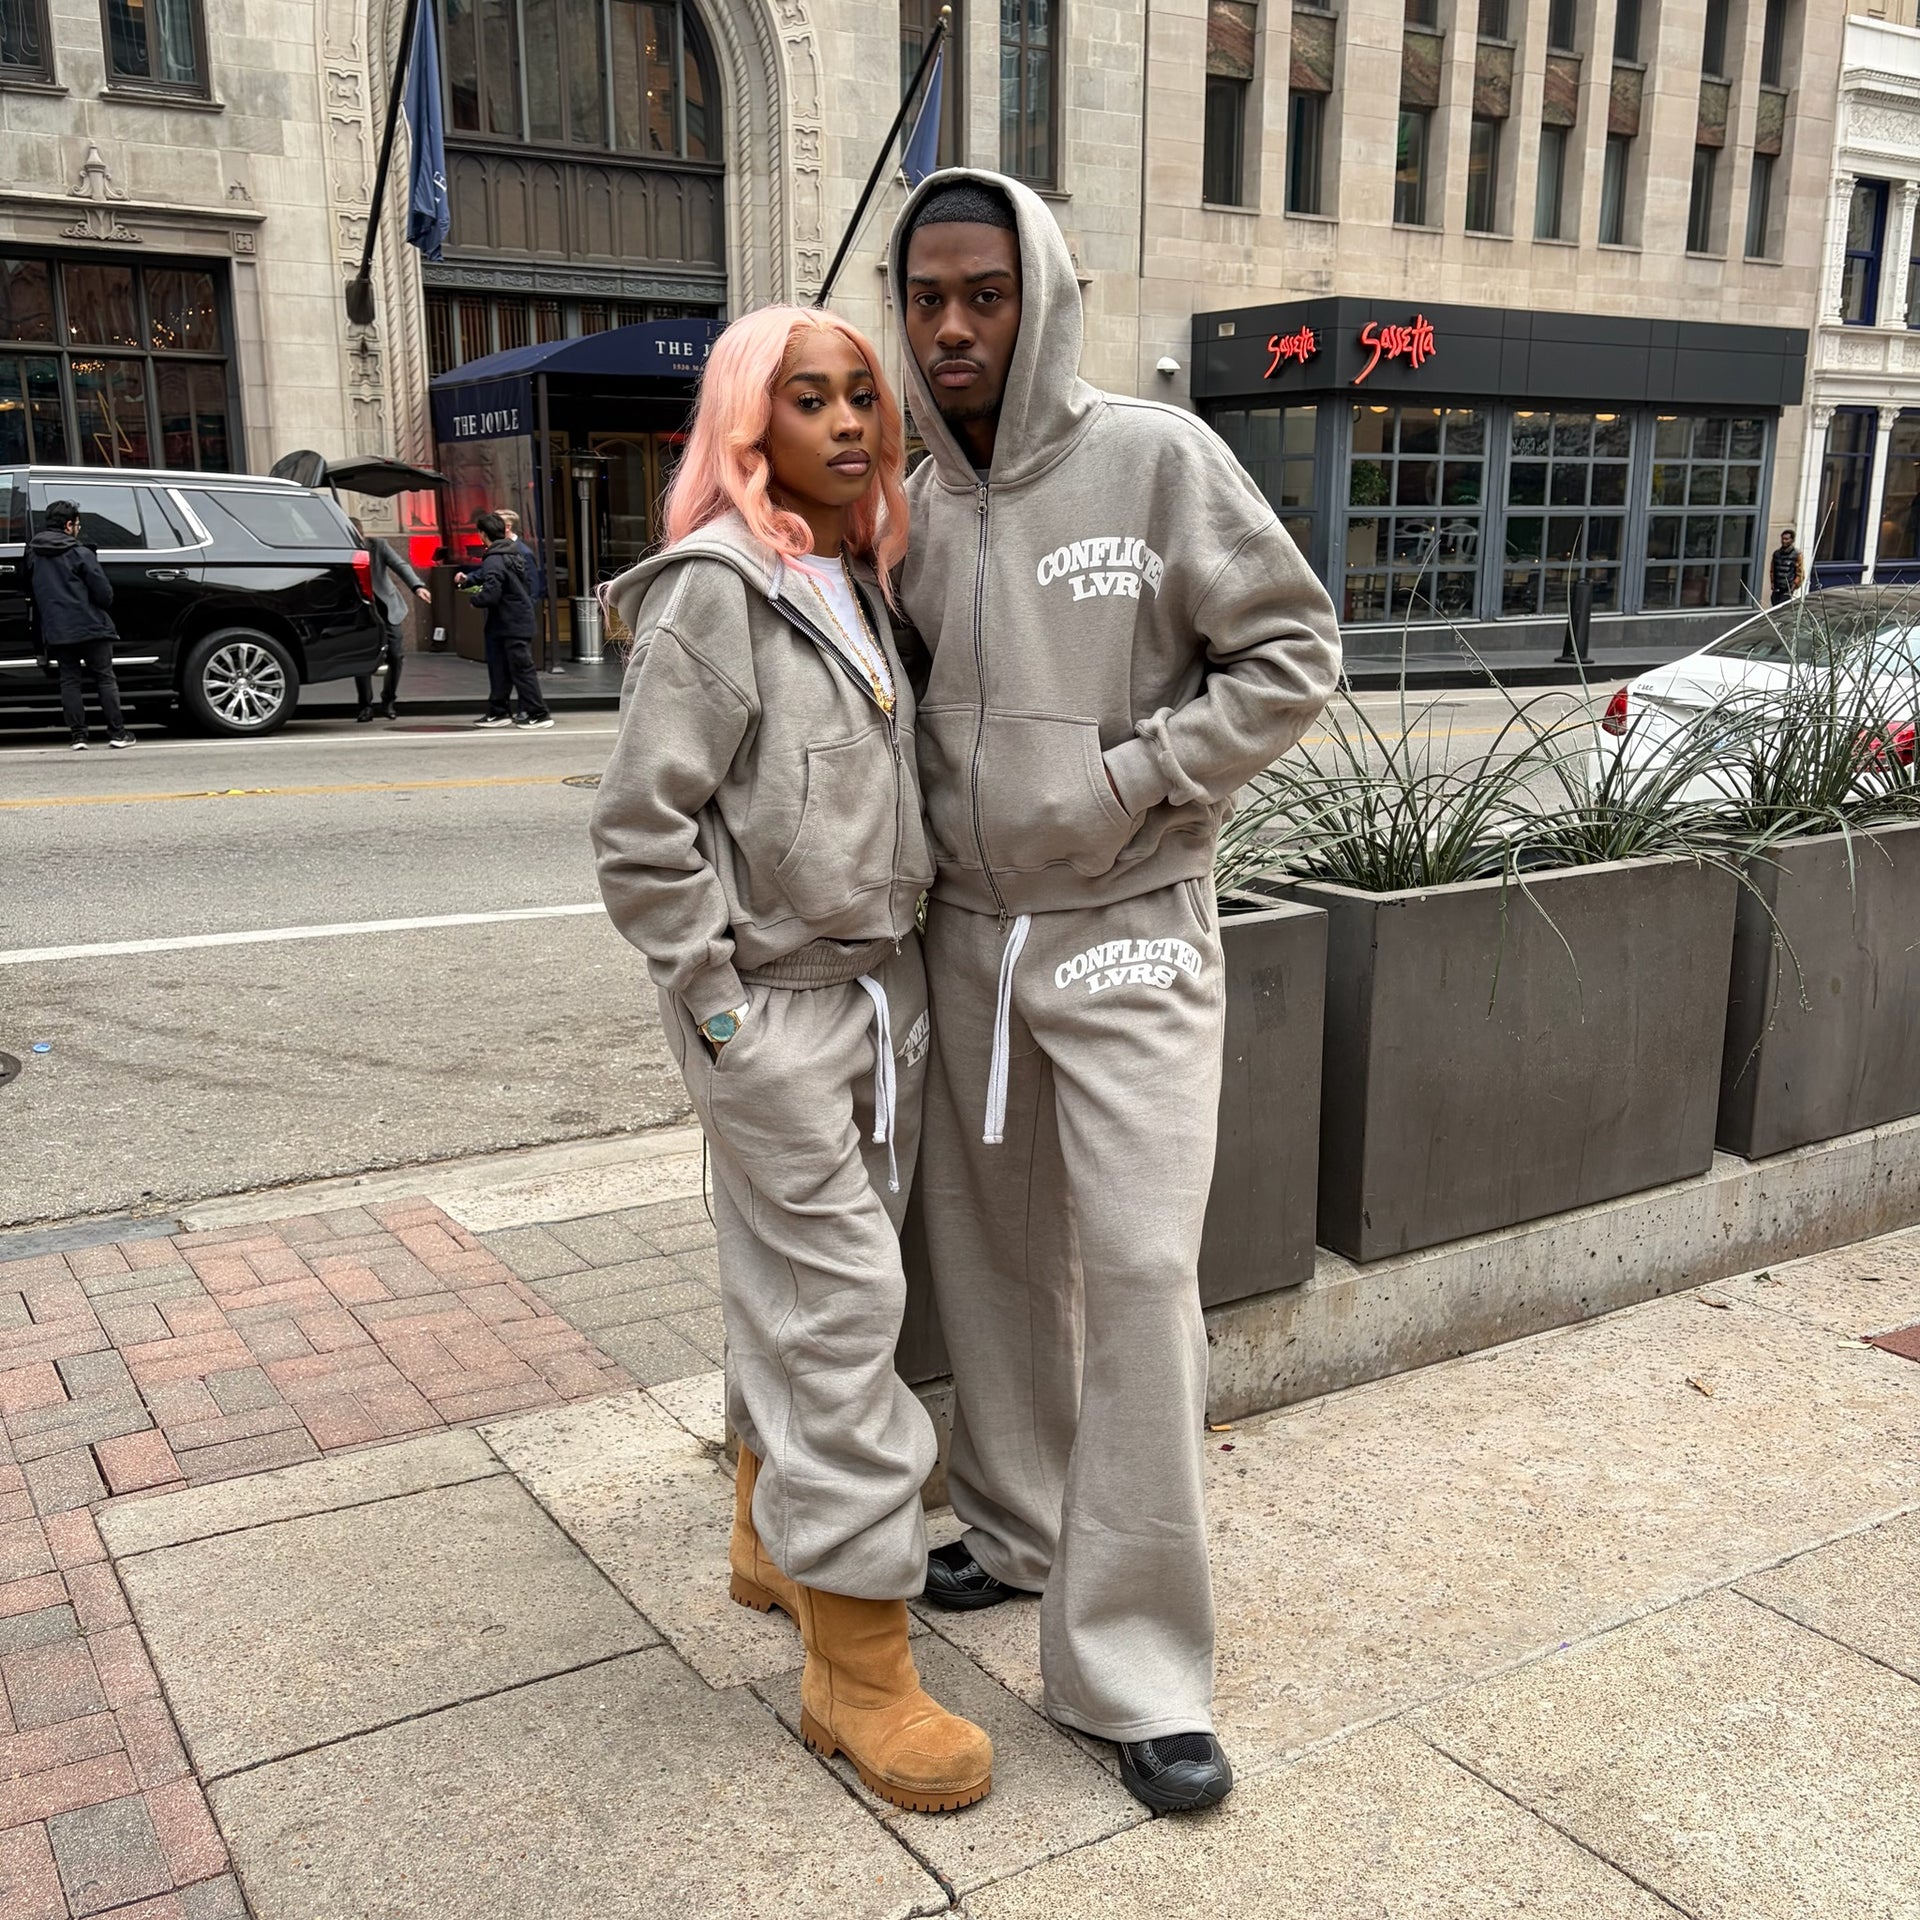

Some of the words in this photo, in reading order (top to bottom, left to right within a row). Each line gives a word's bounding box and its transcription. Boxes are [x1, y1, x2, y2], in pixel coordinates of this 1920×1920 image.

[655, 341, 693, 356] THE
[1263, 325, 1316, 379] Sassetta
[1354, 314, 1436, 384] Sassetta
[453, 414, 477, 436] THE
[480, 409, 519, 434] JOULE
[1054, 938, 1202, 989] CONFLICTED
[1085, 963, 1177, 994] LVRS
